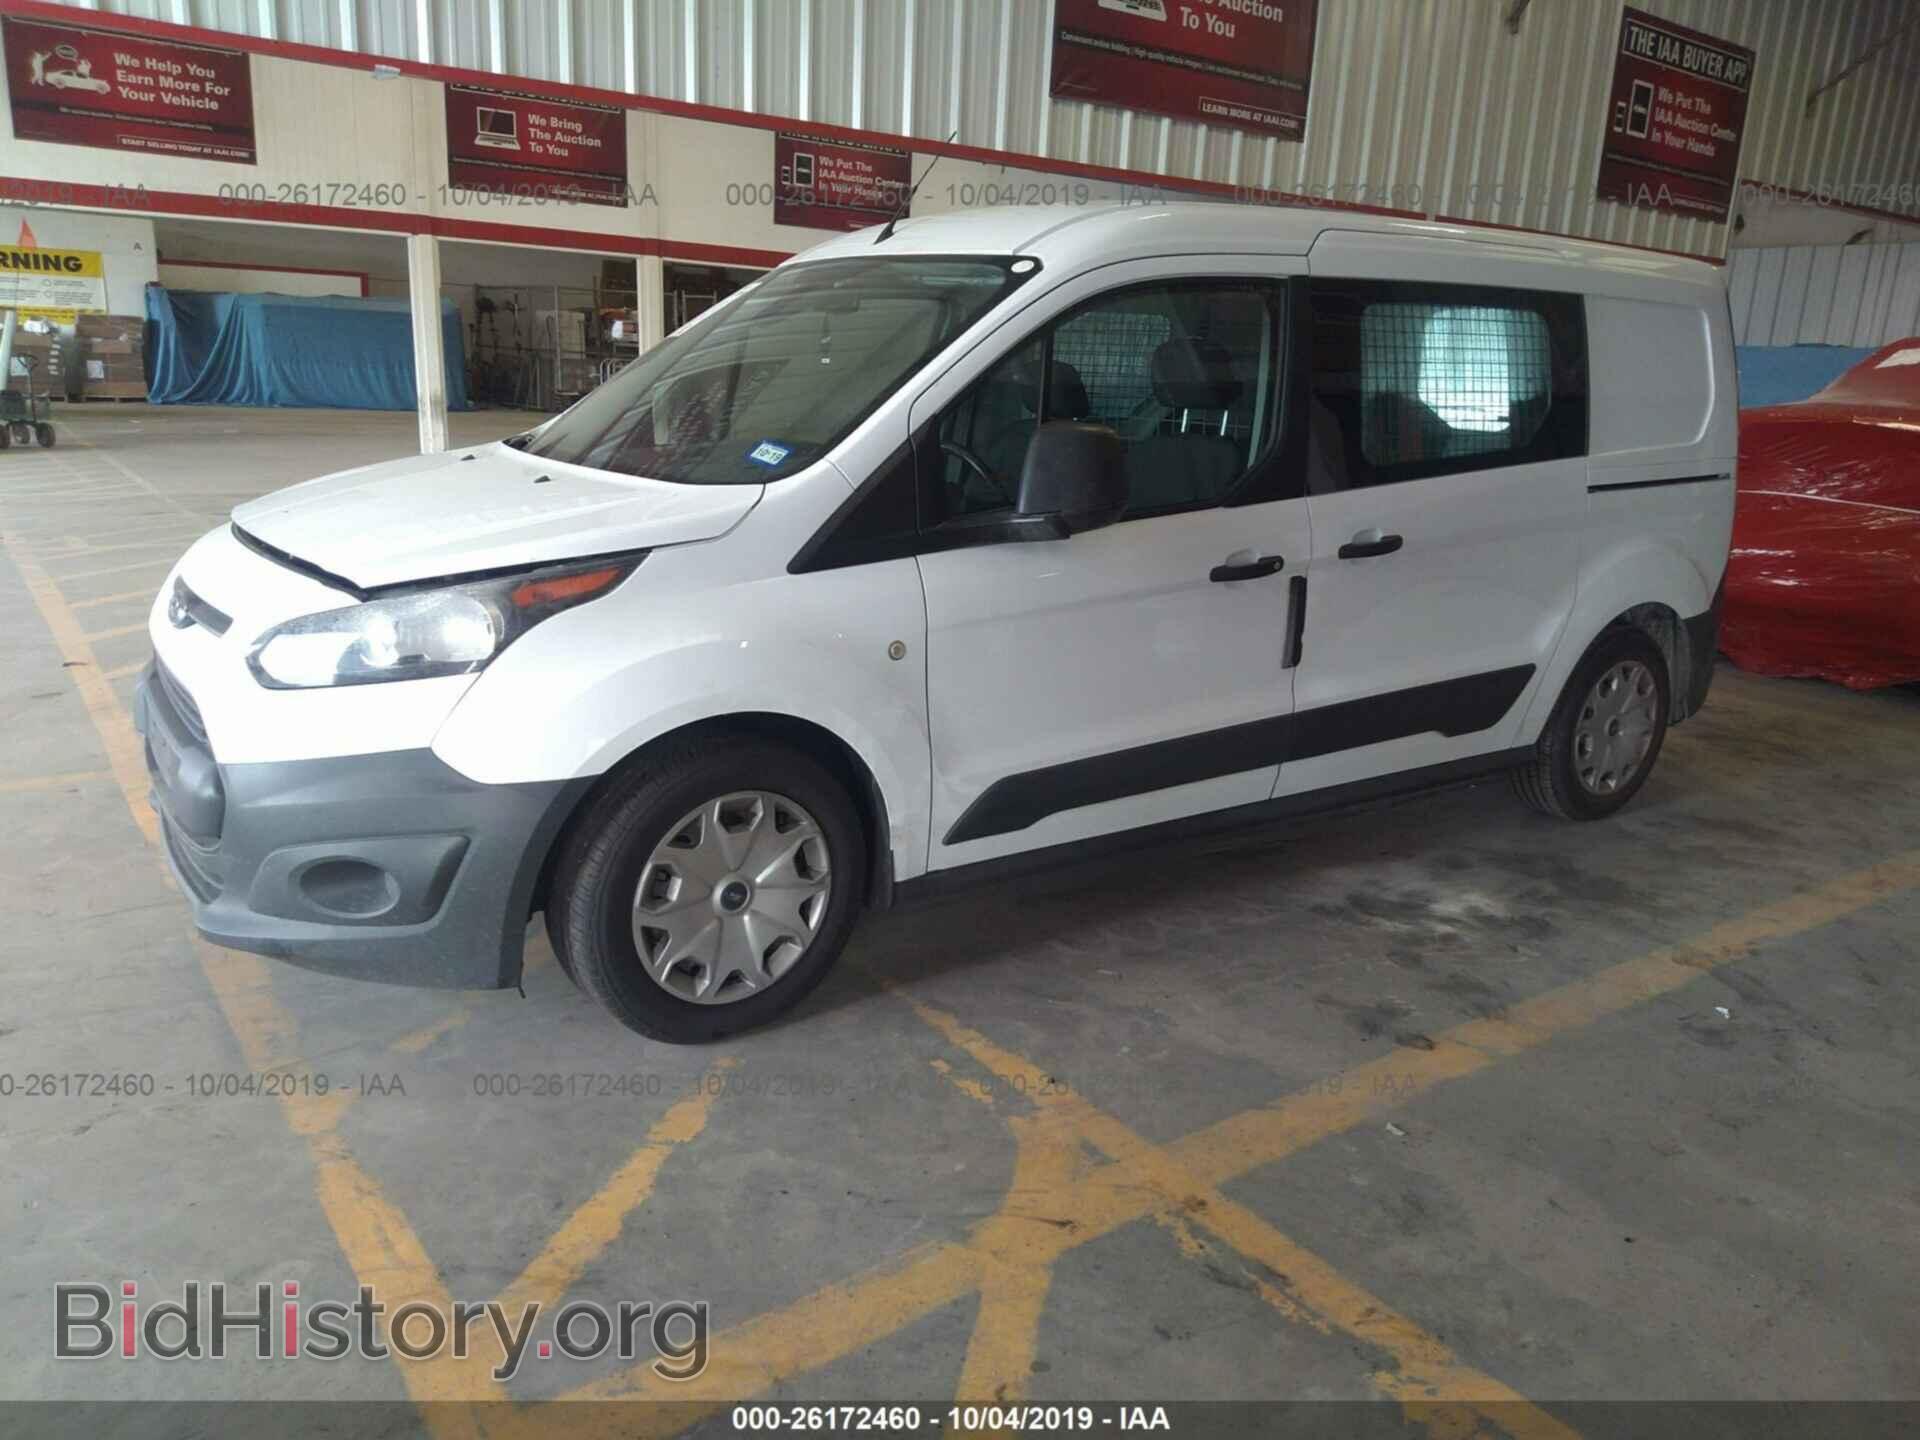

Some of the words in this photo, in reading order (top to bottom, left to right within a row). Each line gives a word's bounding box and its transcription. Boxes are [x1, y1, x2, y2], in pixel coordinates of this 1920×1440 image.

[1180, 6, 1200, 29] To
[1205, 12, 1236, 38] You
[114, 52, 141, 67] We
[145, 57, 182, 76] Help
[187, 64, 216, 78] You
[1630, 26, 1654, 56] THE
[1656, 36, 1680, 64] IAA
[1682, 44, 1723, 76] BUYER
[1724, 58, 1747, 84] APP
[116, 69, 154, 86] Earn
[159, 76, 201, 92] More
[205, 82, 231, 96] For
[118, 86, 156, 102] Your
[160, 91, 219, 110] Vehicle
[1658, 86, 1673, 104] We
[1675, 91, 1693, 109] Put
[1694, 96, 1712, 114] The
[528, 114, 547, 127] We
[550, 117, 583, 133] Bring
[1202, 102, 1229, 116] LEARN
[1253, 112, 1263, 122] AT
[1654, 107, 1673, 124] IAA
[1674, 113, 1710, 135] Auction
[528, 127, 551, 141] The
[554, 131, 602, 148] Auction
[528, 141, 543, 153] To
[546, 144, 569, 157] You
[1651, 127, 1662, 142] In
[1664, 130, 1686, 149] Your
[1686, 136, 1716, 157] Hands
[818, 155, 834, 167] We
[836, 158, 854, 169] Put
[855, 161, 873, 172] The
[819, 168, 836, 178] IAA
[838, 171, 874, 185] Auction
[819, 180, 828, 191] In
[831, 182, 852, 194] Your
